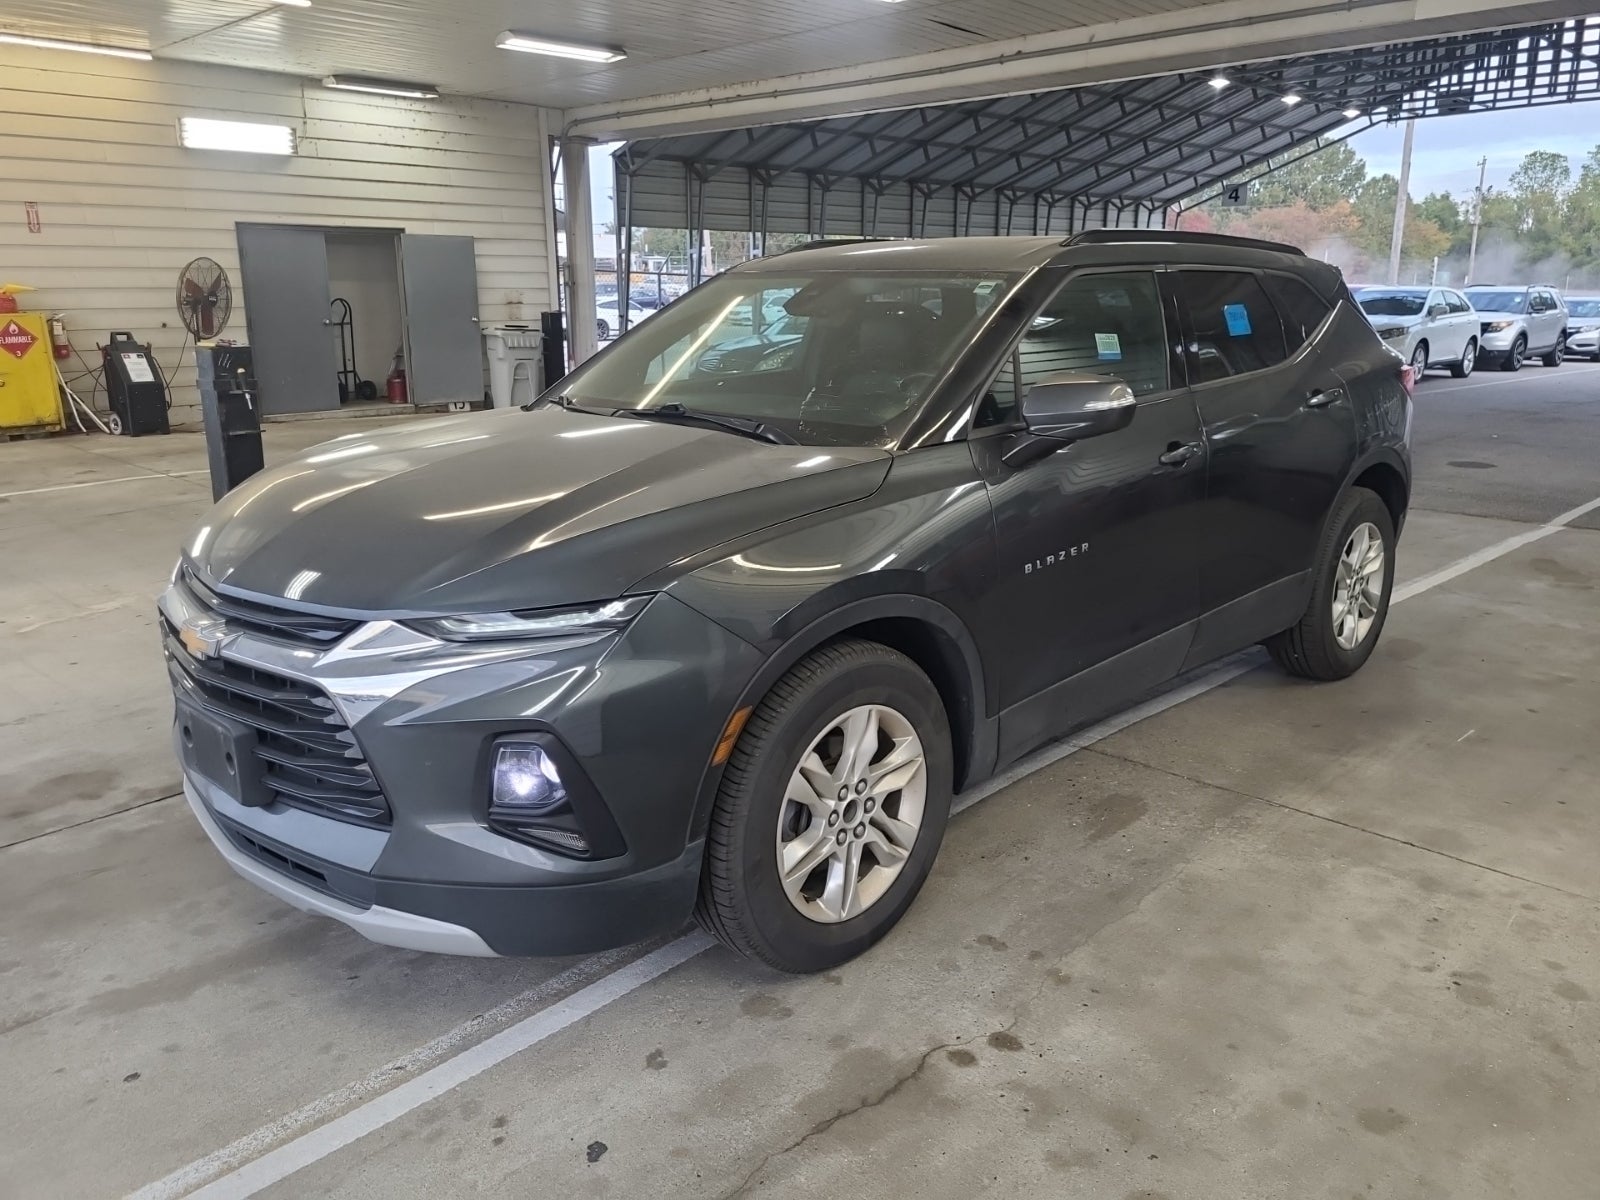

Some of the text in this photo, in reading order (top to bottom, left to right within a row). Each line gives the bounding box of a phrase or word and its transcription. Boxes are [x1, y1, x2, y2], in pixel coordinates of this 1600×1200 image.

[1228, 188, 1240, 202] 4
[0, 335, 33, 344] FLAMMABLE
[1024, 542, 1089, 574] BLAZER
